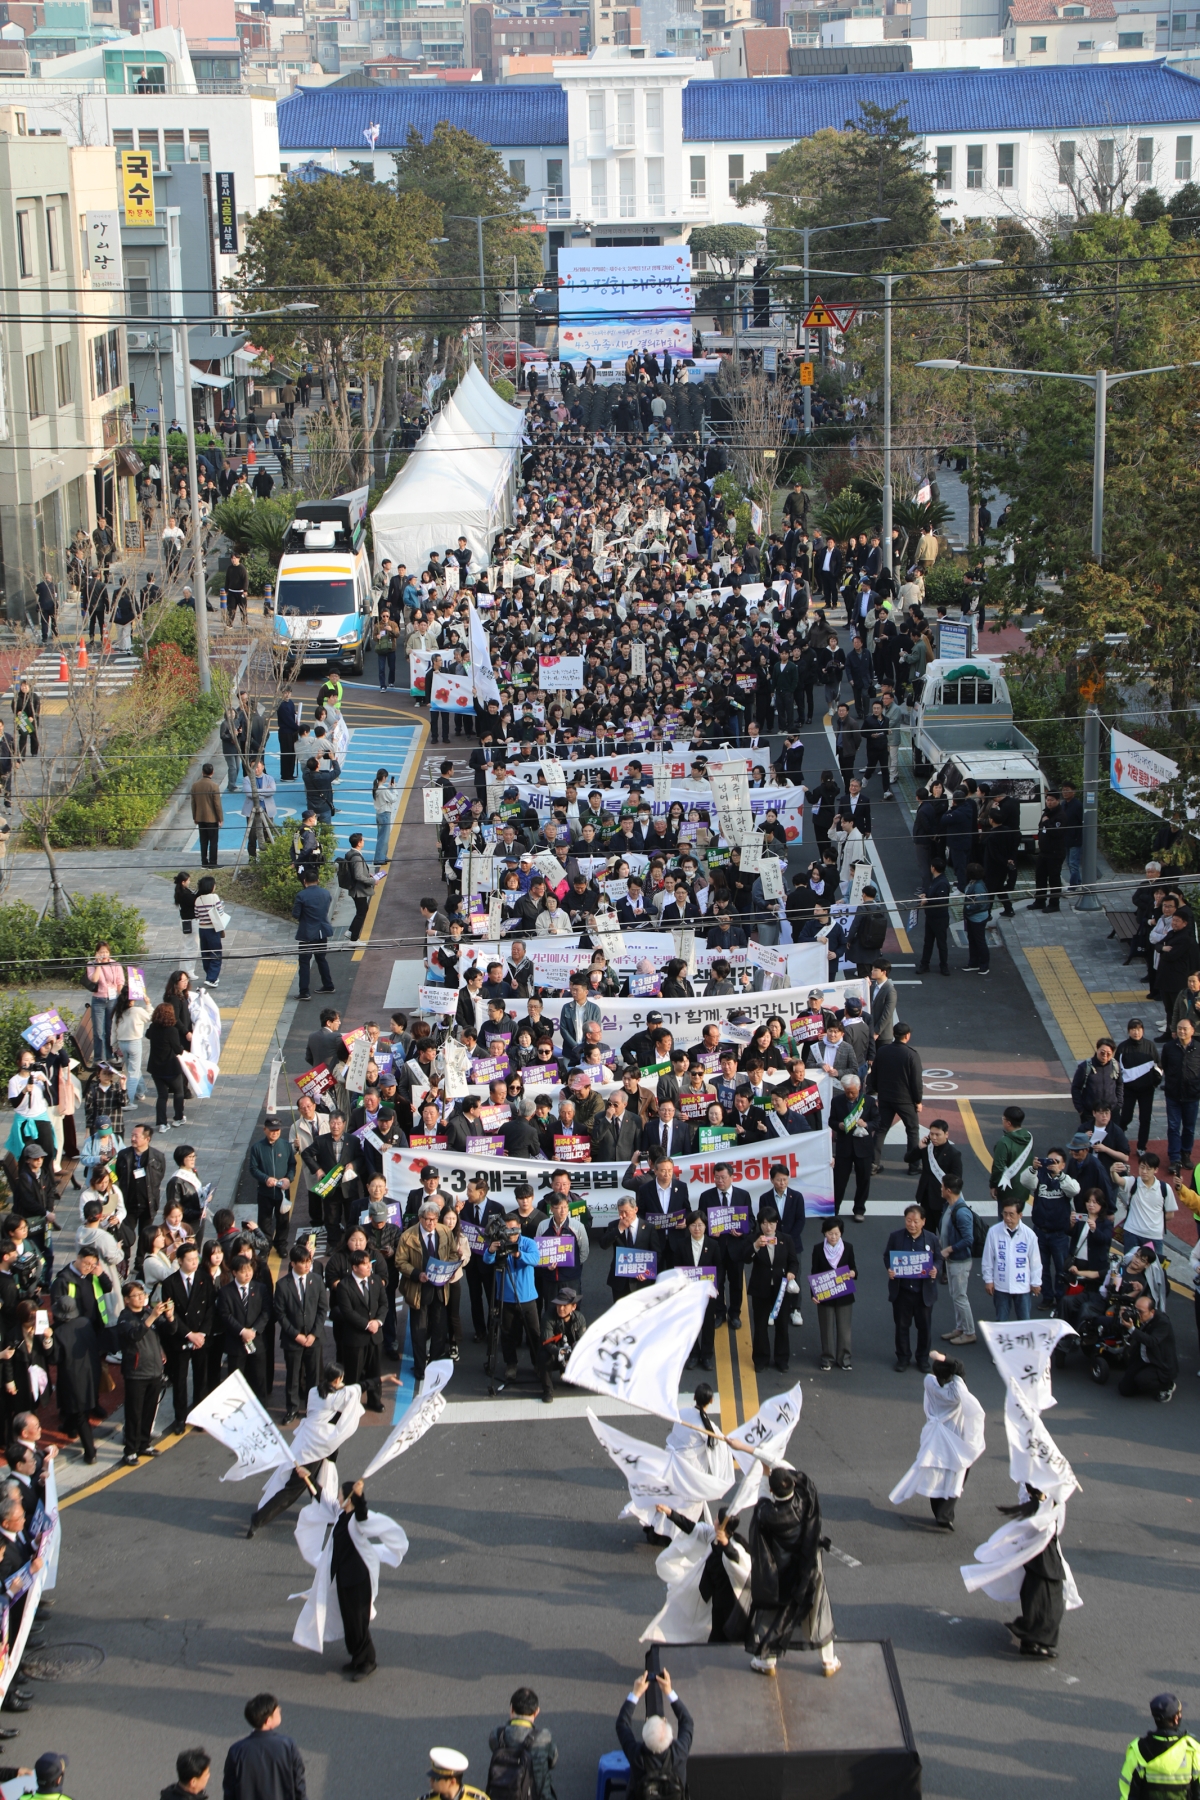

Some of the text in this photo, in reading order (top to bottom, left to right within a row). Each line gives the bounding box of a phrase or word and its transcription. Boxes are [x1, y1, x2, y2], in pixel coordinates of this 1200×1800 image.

[126, 156, 150, 206] 국수
[221, 174, 230, 196] 법무사
[127, 209, 153, 217] 전문점
[642, 226, 656, 234] 제주
[224, 226, 232, 248] 사무소
[93, 222, 115, 270] 아리랑
[593, 276, 625, 295] 평화
[632, 274, 682, 294] 대행진
[636, 338, 677, 350] 결의대회
[1138, 768, 1150, 788] 통행
[532, 954, 570, 964] 거리에서
[572, 954, 591, 964] 기억
[630, 978, 644, 988] 4·3
[629, 1011, 681, 1028] 우가
[684, 1008, 720, 1025] 함께
[474, 1058, 498, 1070] 4·3왜곡
[494, 1062, 508, 1070] 즉각
[524, 1066, 546, 1076] 4·3왜곡
[544, 1070, 557, 1078] 즉각
[681, 1096, 705, 1105] 제주4·3은
[787, 1091, 810, 1104] 제주4·3은
[700, 1130, 712, 1138] 4·3
[700, 1132, 736, 1144] 특별법 즉각
[412, 1137, 436, 1146] 제주4·3은
[468, 1137, 492, 1146] 4·3왜곡
[555, 1138, 580, 1146] 제주4·3은
[572, 1143, 590, 1152] 기록이자
[700, 1140, 730, 1152] 개정하라!
[468, 1144, 488, 1154] 처벌법
[475, 1169, 529, 1193] 왜곡
[572, 1206, 586, 1216] 즉각
[710, 1208, 735, 1218] 4·3왜곡
[710, 1213, 747, 1226] 처벌법 즉각
[710, 1224, 741, 1234] 제정하라!
[558, 1244, 573, 1253] 즉각
[618, 1252, 654, 1264] 4·3 평화
[892, 1252, 930, 1266] 4·3 평화
[998, 1240, 1006, 1272] 교육감
[1015, 1241, 1028, 1283] 송문석
[427, 1262, 444, 1274] 4·3
[618, 1262, 646, 1274] 대행진
[893, 1264, 922, 1276] 대행진
[700, 1274, 716, 1283] 즉각
[812, 1270, 837, 1286] 4·3왜곡
[814, 1274, 851, 1294] 처벌법 즉각
[816, 1284, 847, 1300] 제정하라!
